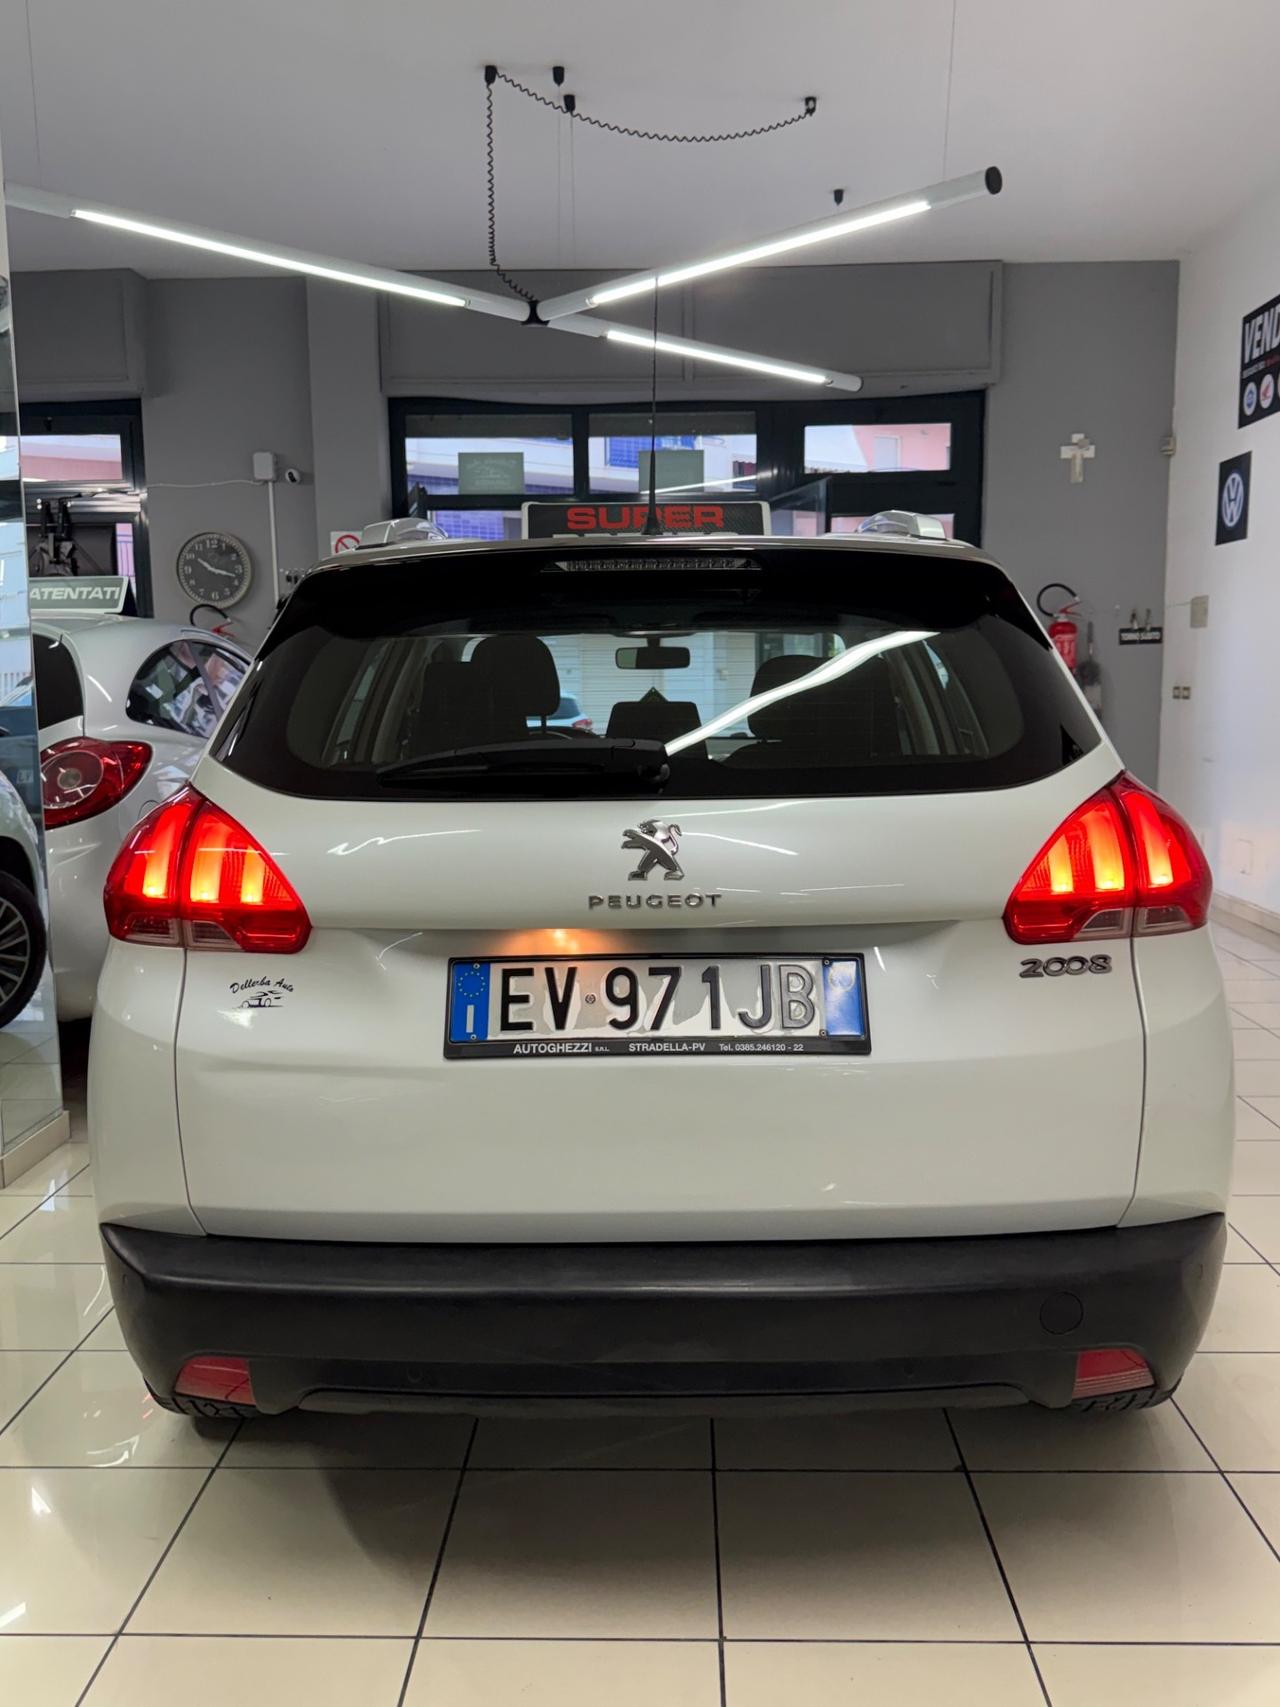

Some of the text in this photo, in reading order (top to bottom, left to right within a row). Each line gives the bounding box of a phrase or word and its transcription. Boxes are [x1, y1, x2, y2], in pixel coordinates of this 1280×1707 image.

[588, 893, 722, 911] PEUGEOT
[1019, 954, 1112, 978] 2008
[273, 978, 294, 993] Auto
[513, 1042, 592, 1055] AUTOGHEZZI
[628, 1042, 706, 1052] STRADELLA-PV
[719, 1043, 734, 1051] Tel.
[793, 1043, 804, 1051] 22
